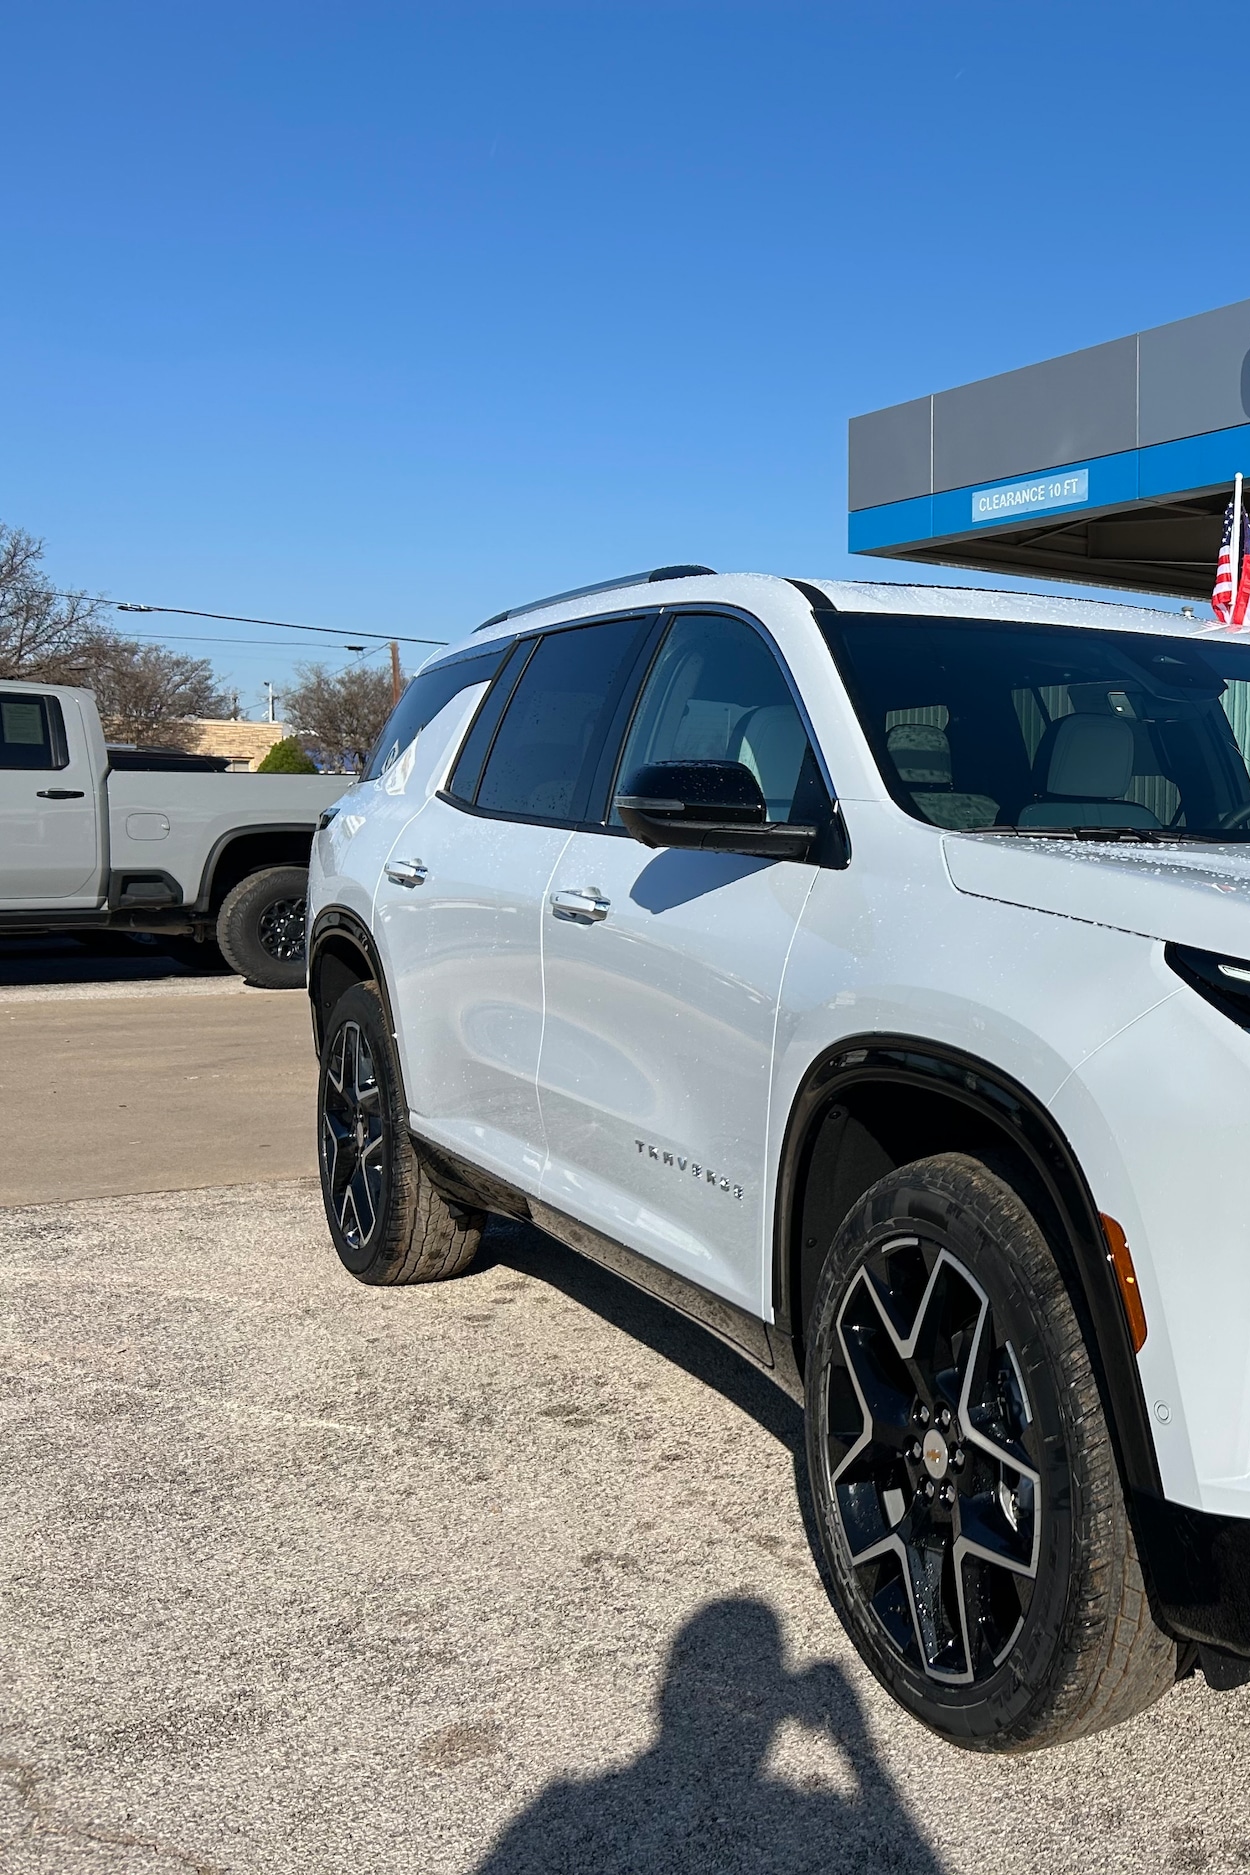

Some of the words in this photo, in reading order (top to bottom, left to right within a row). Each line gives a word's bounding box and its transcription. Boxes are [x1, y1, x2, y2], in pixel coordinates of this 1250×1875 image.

[979, 485, 1046, 512] CLEARANCE
[1049, 483, 1061, 498] 10
[1064, 478, 1079, 496] FT
[634, 1139, 744, 1200] TRAVERSE
